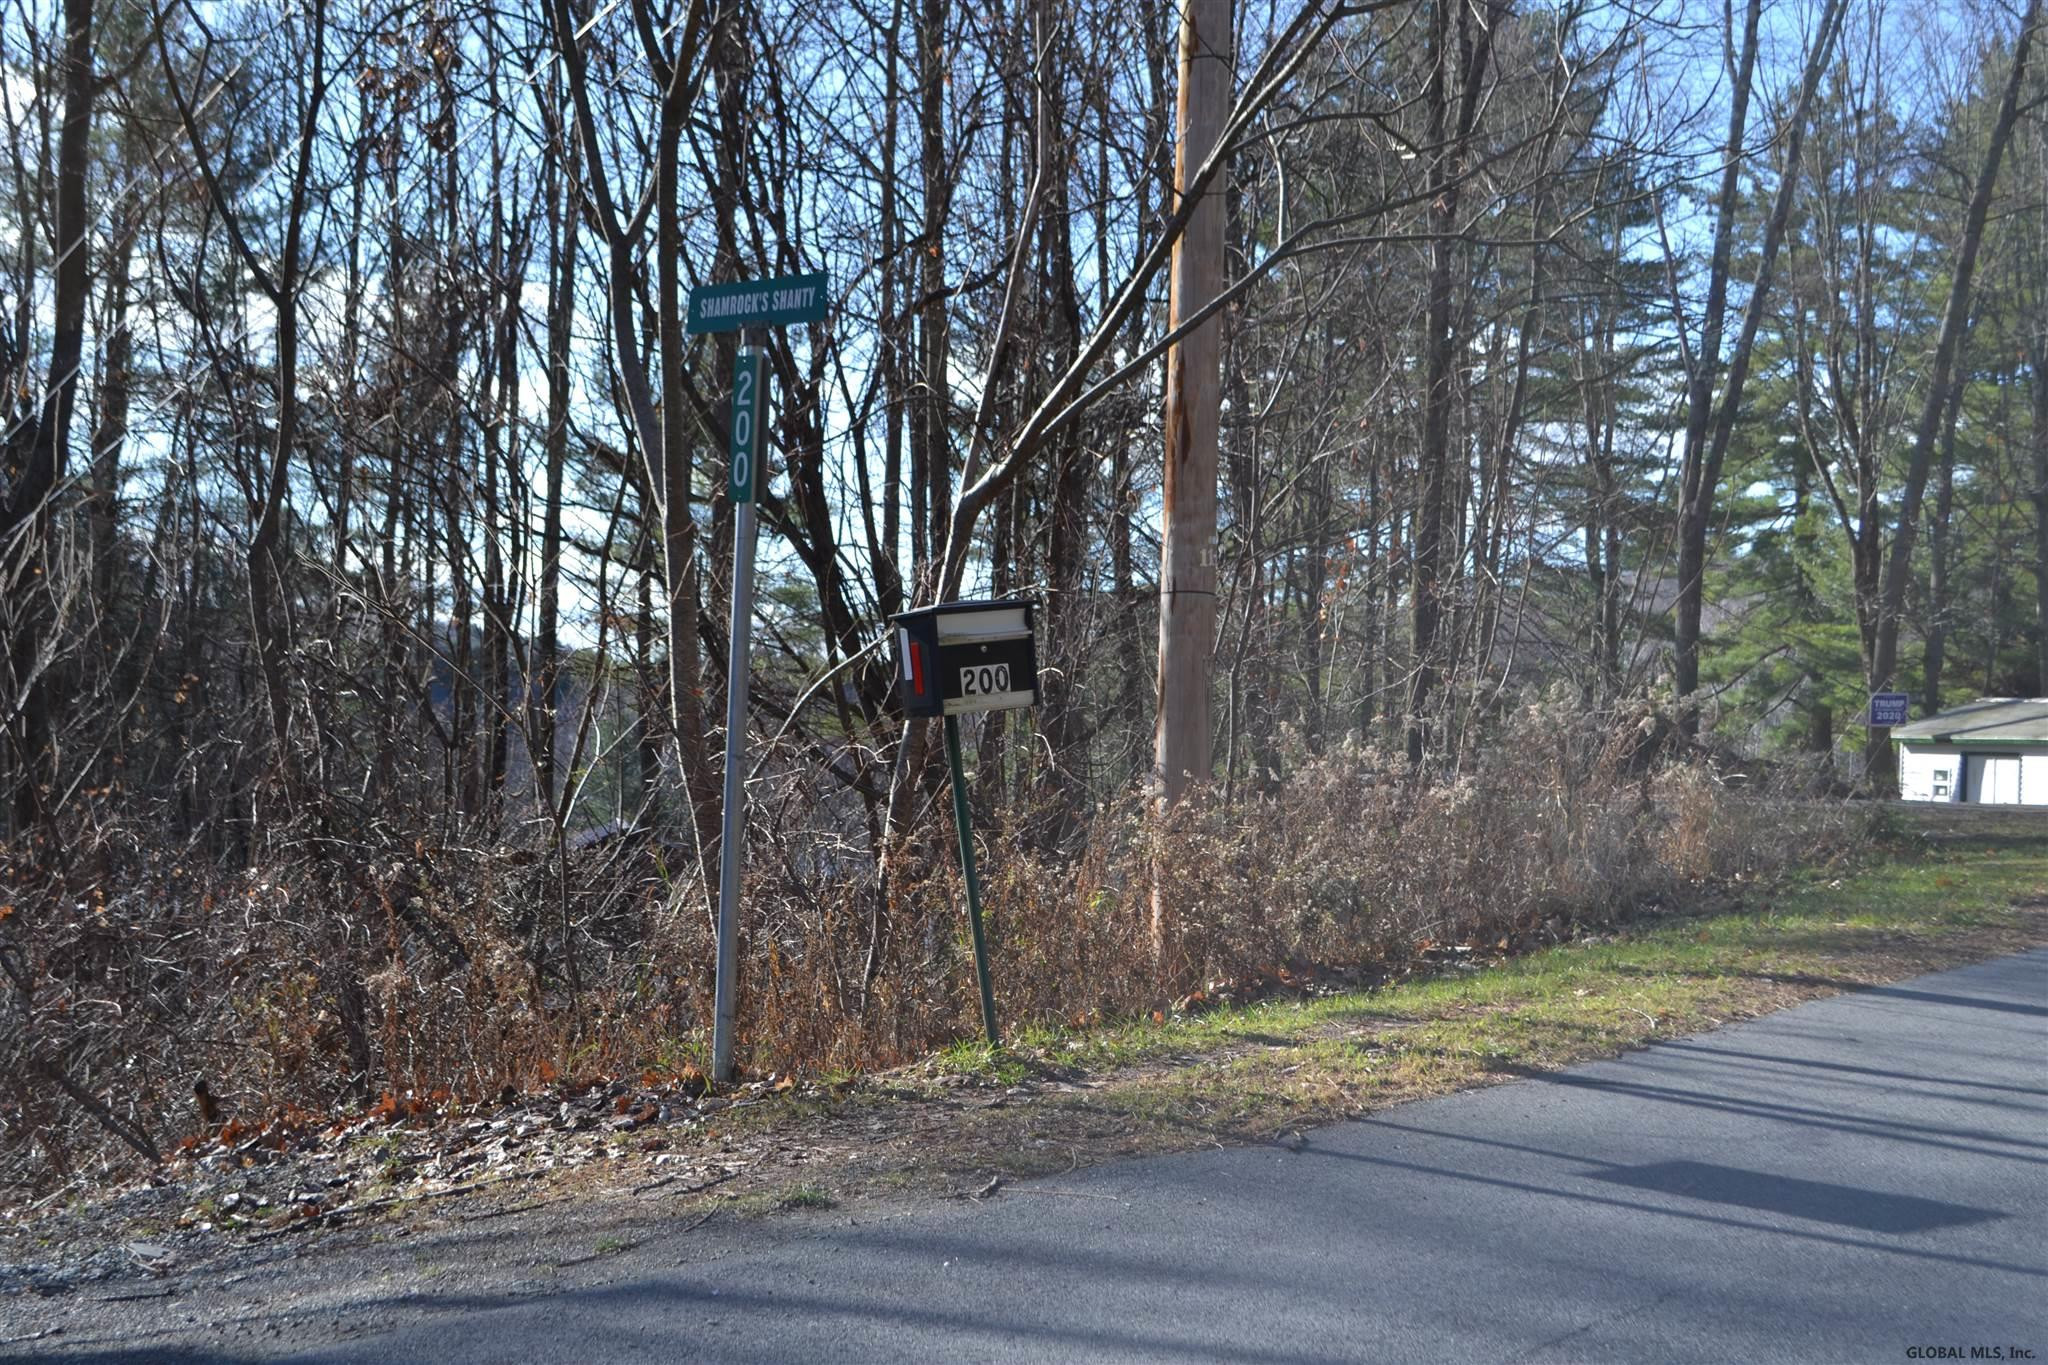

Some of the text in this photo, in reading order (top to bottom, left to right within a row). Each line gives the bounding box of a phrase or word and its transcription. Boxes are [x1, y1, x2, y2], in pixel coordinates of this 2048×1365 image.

[700, 287, 816, 319] SHAMROCK'S SHANTY
[733, 370, 752, 487] 200
[963, 665, 1009, 695] 200
[1874, 699, 1905, 708] TRUMP
